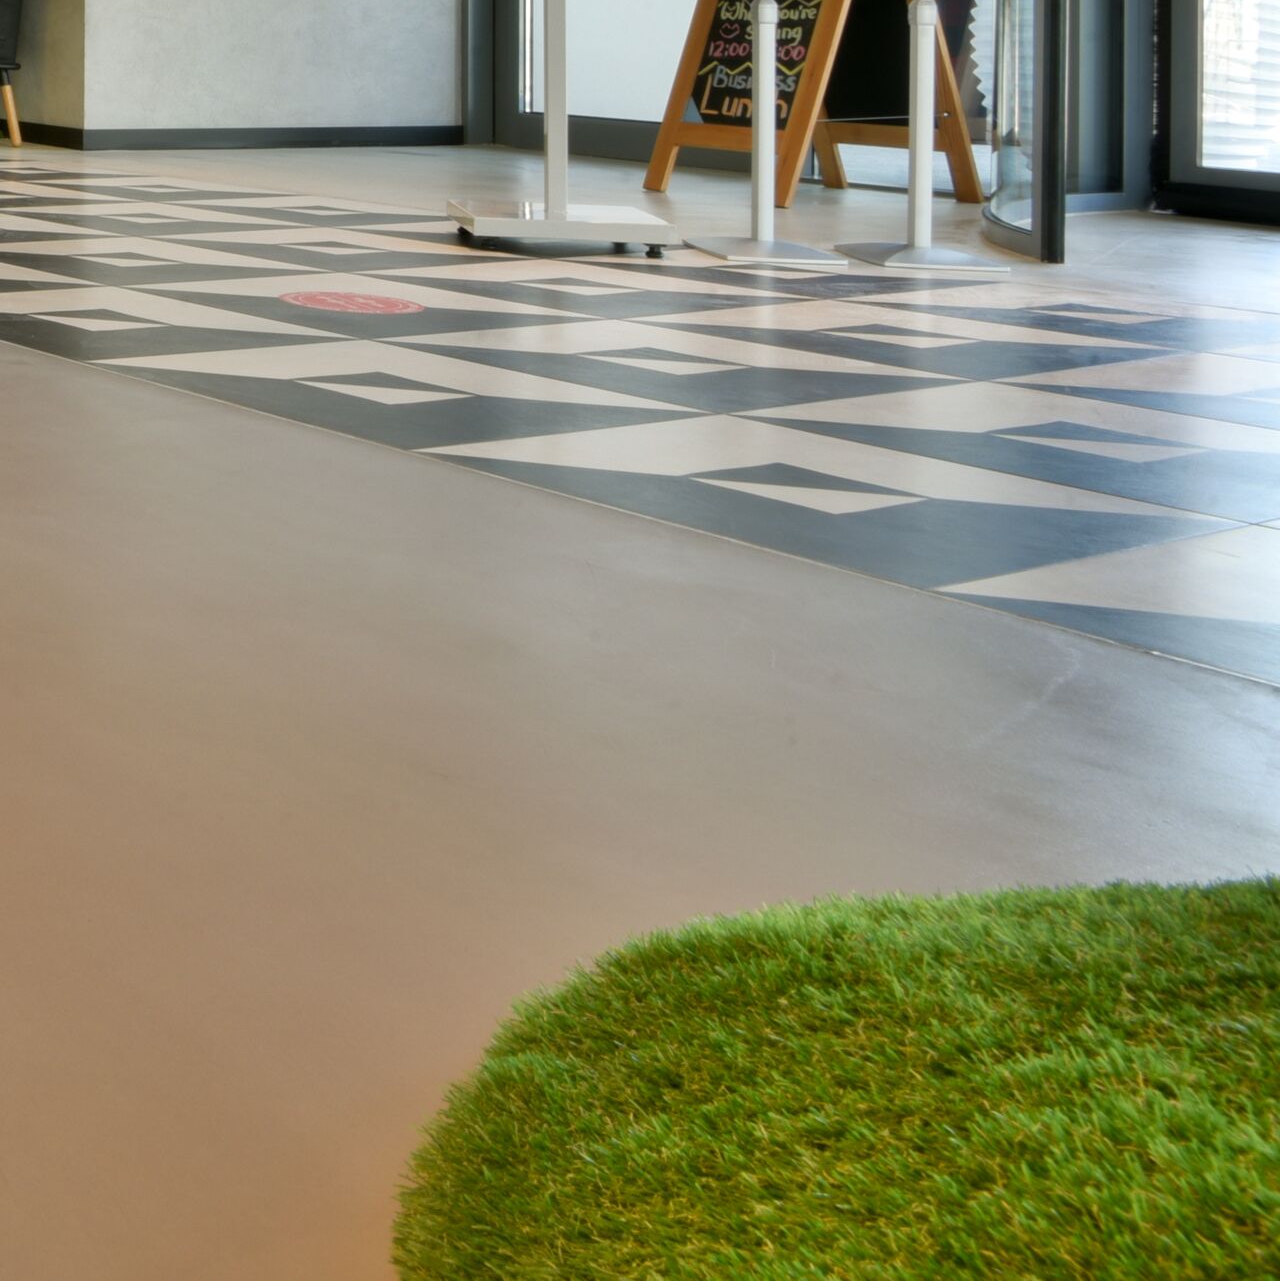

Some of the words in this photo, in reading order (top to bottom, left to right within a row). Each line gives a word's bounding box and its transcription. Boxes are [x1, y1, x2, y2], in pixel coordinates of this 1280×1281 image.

[779, 5, 817, 21] ou're
[713, 65, 797, 92] Busiss
[700, 74, 788, 119] Lunh
